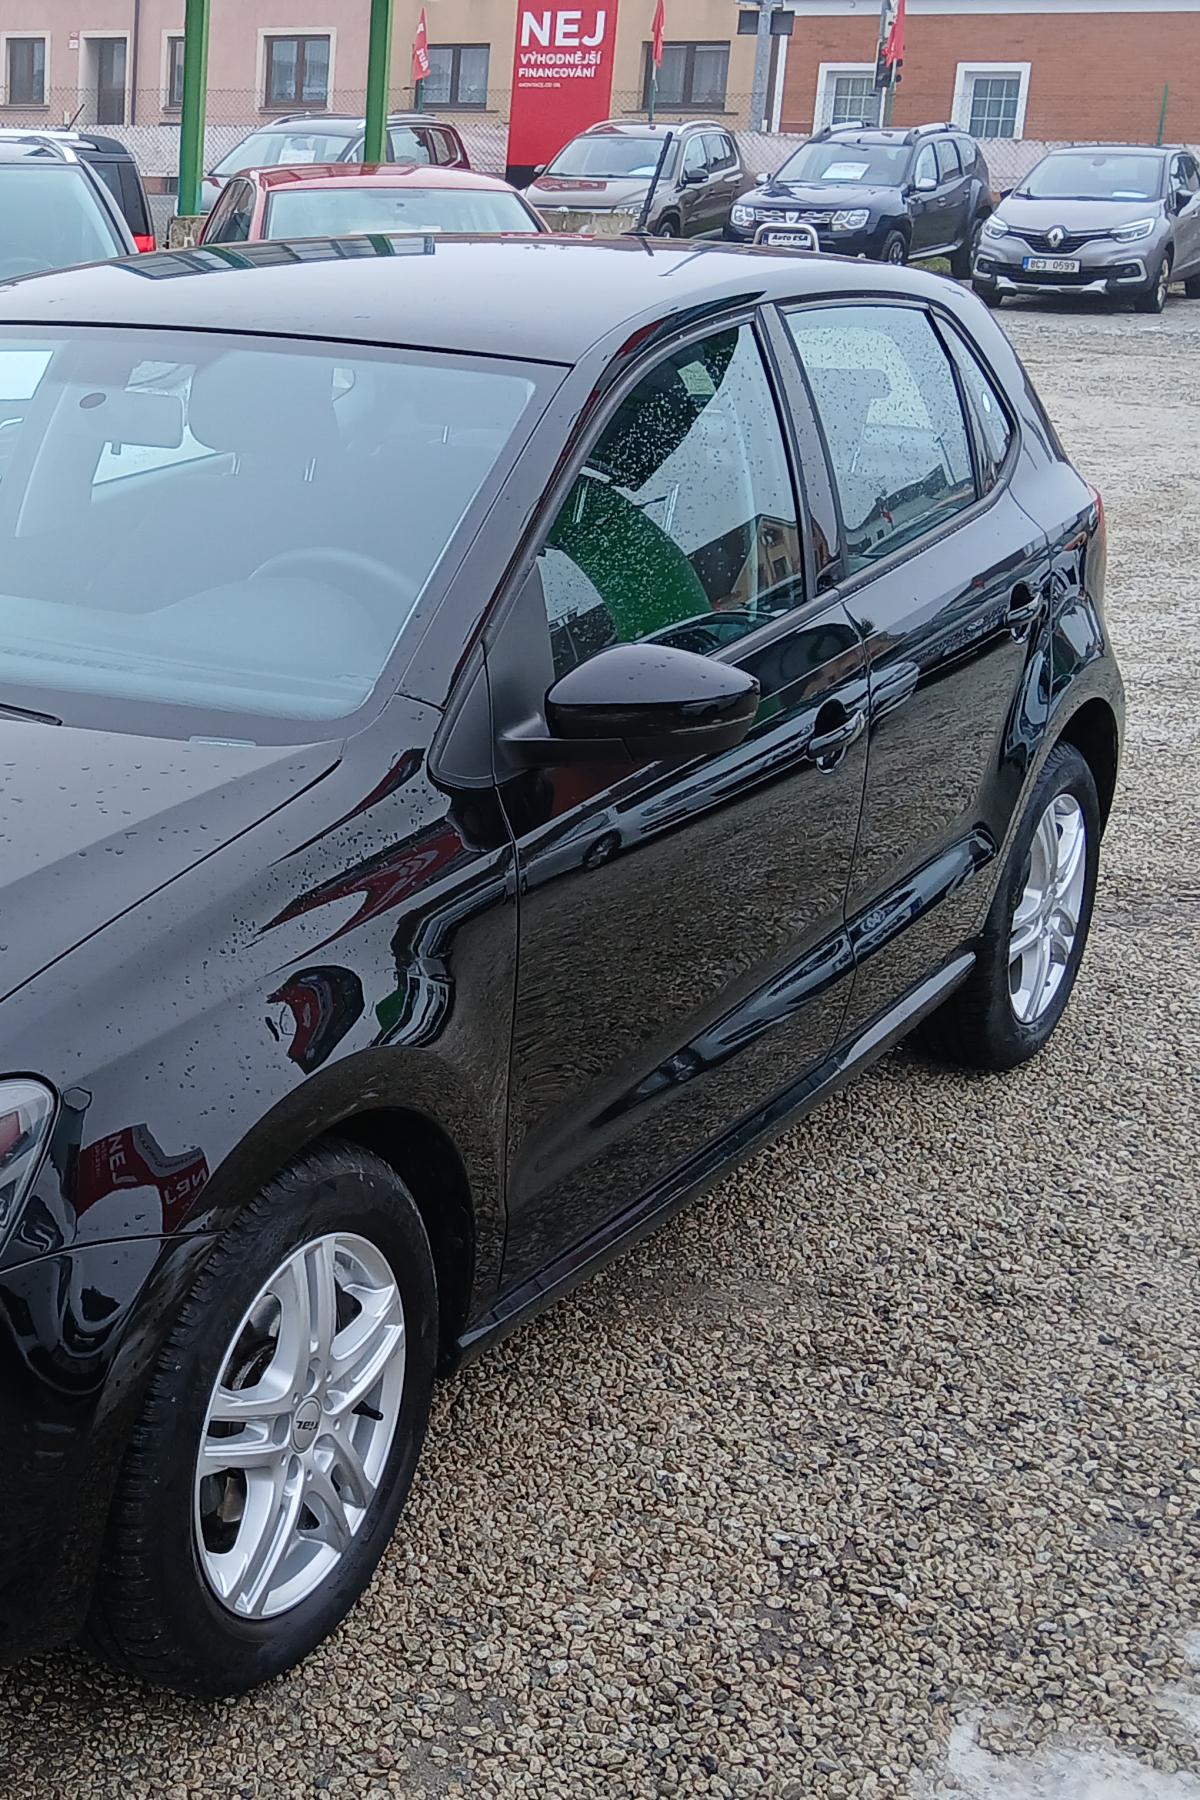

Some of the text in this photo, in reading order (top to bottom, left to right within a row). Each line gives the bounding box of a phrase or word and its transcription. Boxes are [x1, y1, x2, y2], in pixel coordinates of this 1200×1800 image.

[521, 10, 606, 47] NEJ
[520, 50, 602, 65] VÝHODNĚJŠÍ
[518, 66, 596, 78] FINANCOVÁNÍ
